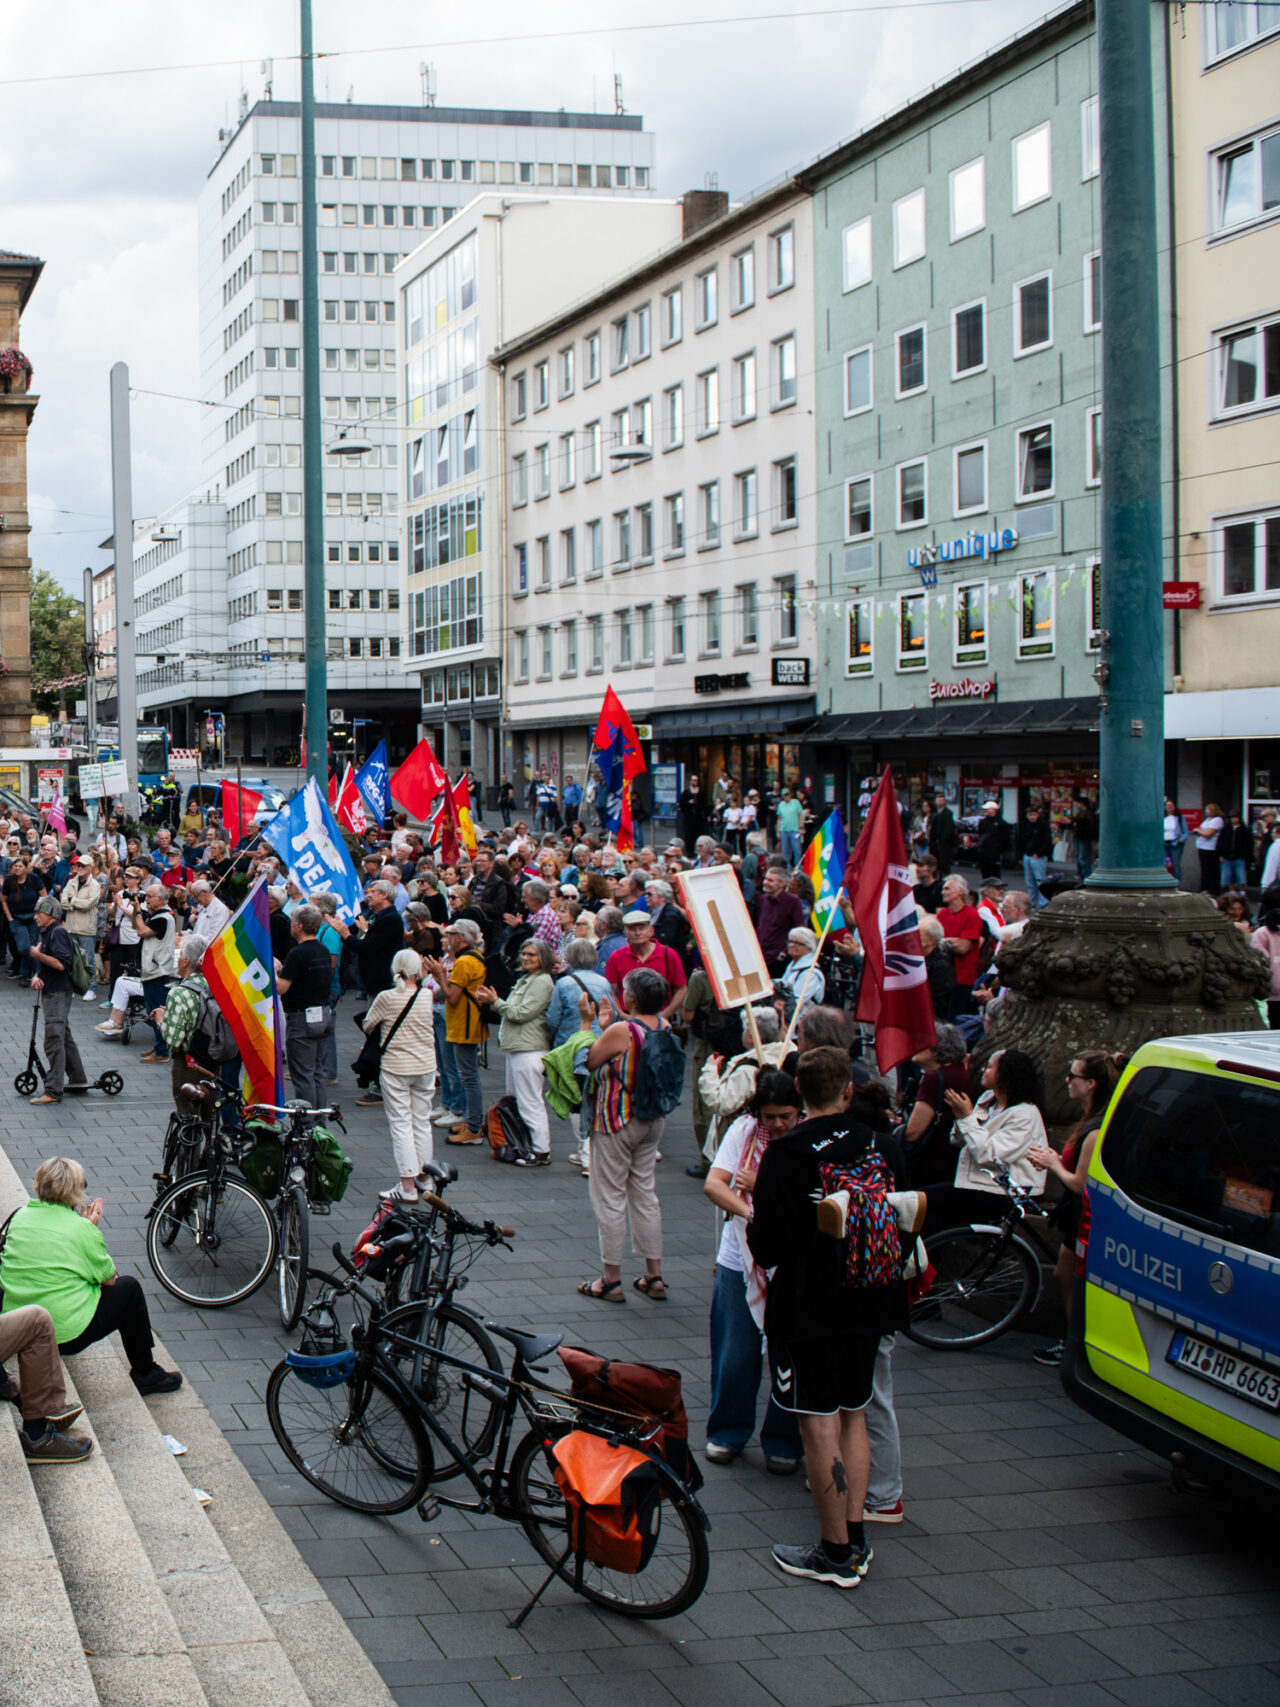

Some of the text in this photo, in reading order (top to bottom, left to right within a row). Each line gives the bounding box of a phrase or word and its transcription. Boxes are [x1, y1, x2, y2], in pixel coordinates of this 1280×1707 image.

[940, 529, 1018, 560] unique
[778, 674, 805, 683] WERK
[779, 662, 803, 672] back
[1104, 1236, 1182, 1292] POLIZEI
[1180, 1338, 1280, 1403] WI HP 6663
